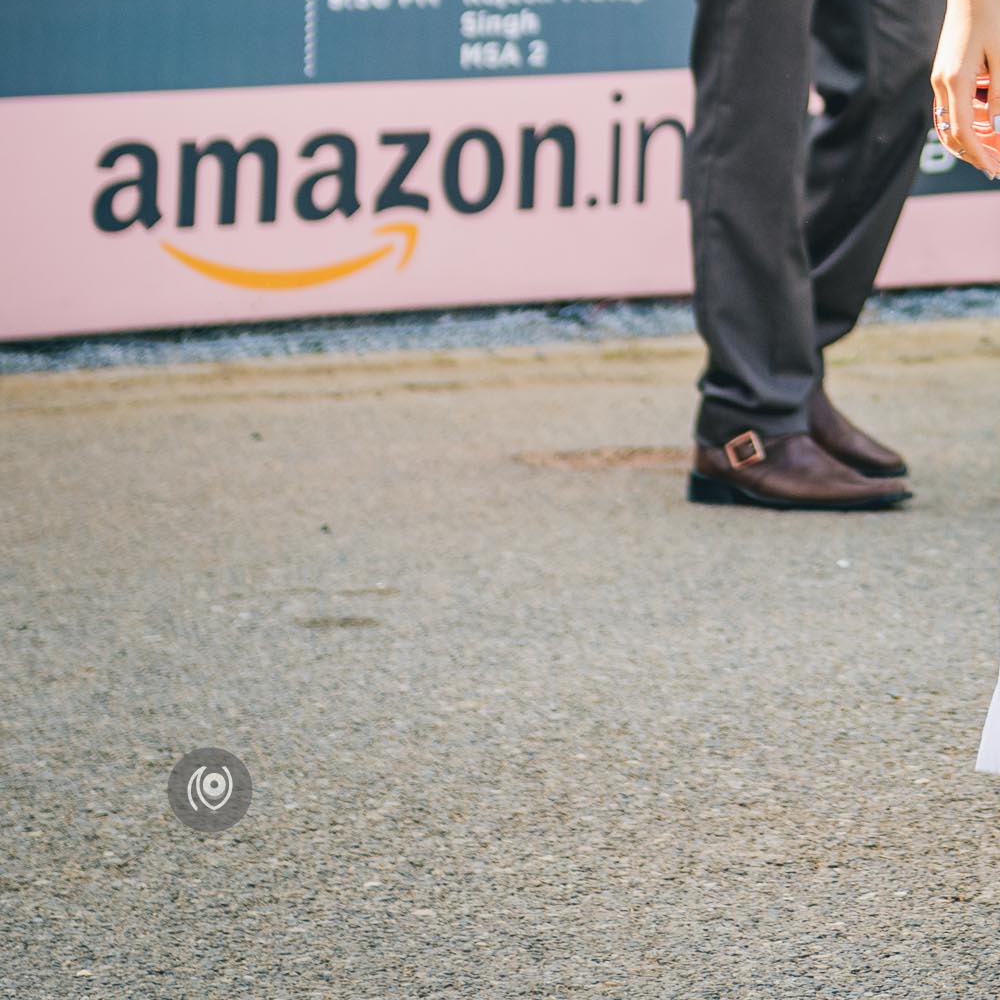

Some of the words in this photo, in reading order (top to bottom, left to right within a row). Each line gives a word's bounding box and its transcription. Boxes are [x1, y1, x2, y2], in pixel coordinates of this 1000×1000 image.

[460, 8, 541, 40] Singh
[460, 41, 524, 70] MSA
[527, 40, 549, 69] 2
[92, 91, 687, 235] amazon.in
